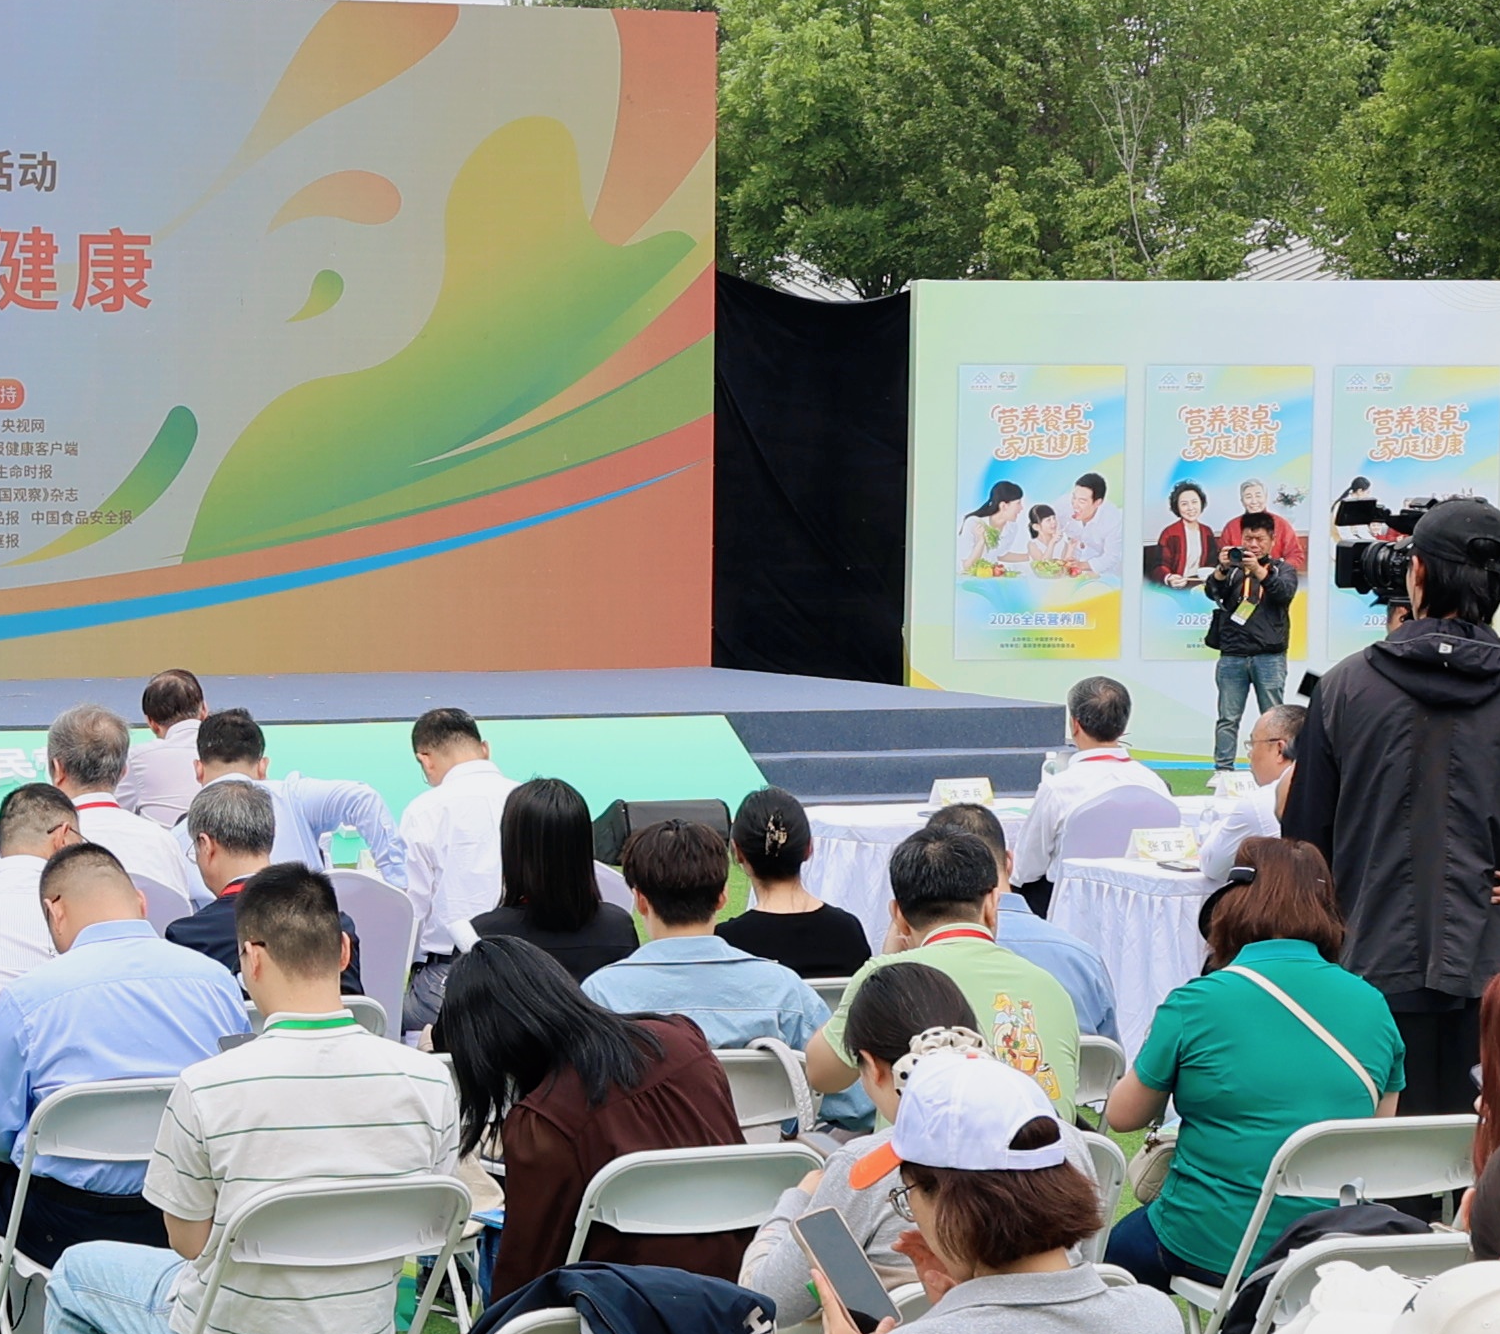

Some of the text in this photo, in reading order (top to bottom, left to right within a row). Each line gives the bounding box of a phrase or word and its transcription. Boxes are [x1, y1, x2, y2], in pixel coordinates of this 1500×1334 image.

[1, 418, 45, 433] 央视网
[997, 404, 1092, 433] 营养餐桌
[1184, 404, 1280, 433] 营养餐桌
[1372, 405, 1467, 435] 营养餐桌
[995, 432, 1090, 459] 家庭健康
[1182, 432, 1276, 460] 家庭健康
[1370, 434, 1464, 461] 家庭健康
[31, 510, 133, 525] 中国食品安全报
[990, 613, 1085, 627] 2026全民营养周
[1364, 615, 1387, 626] 202
[1234, 781, 1256, 792] 杨月
